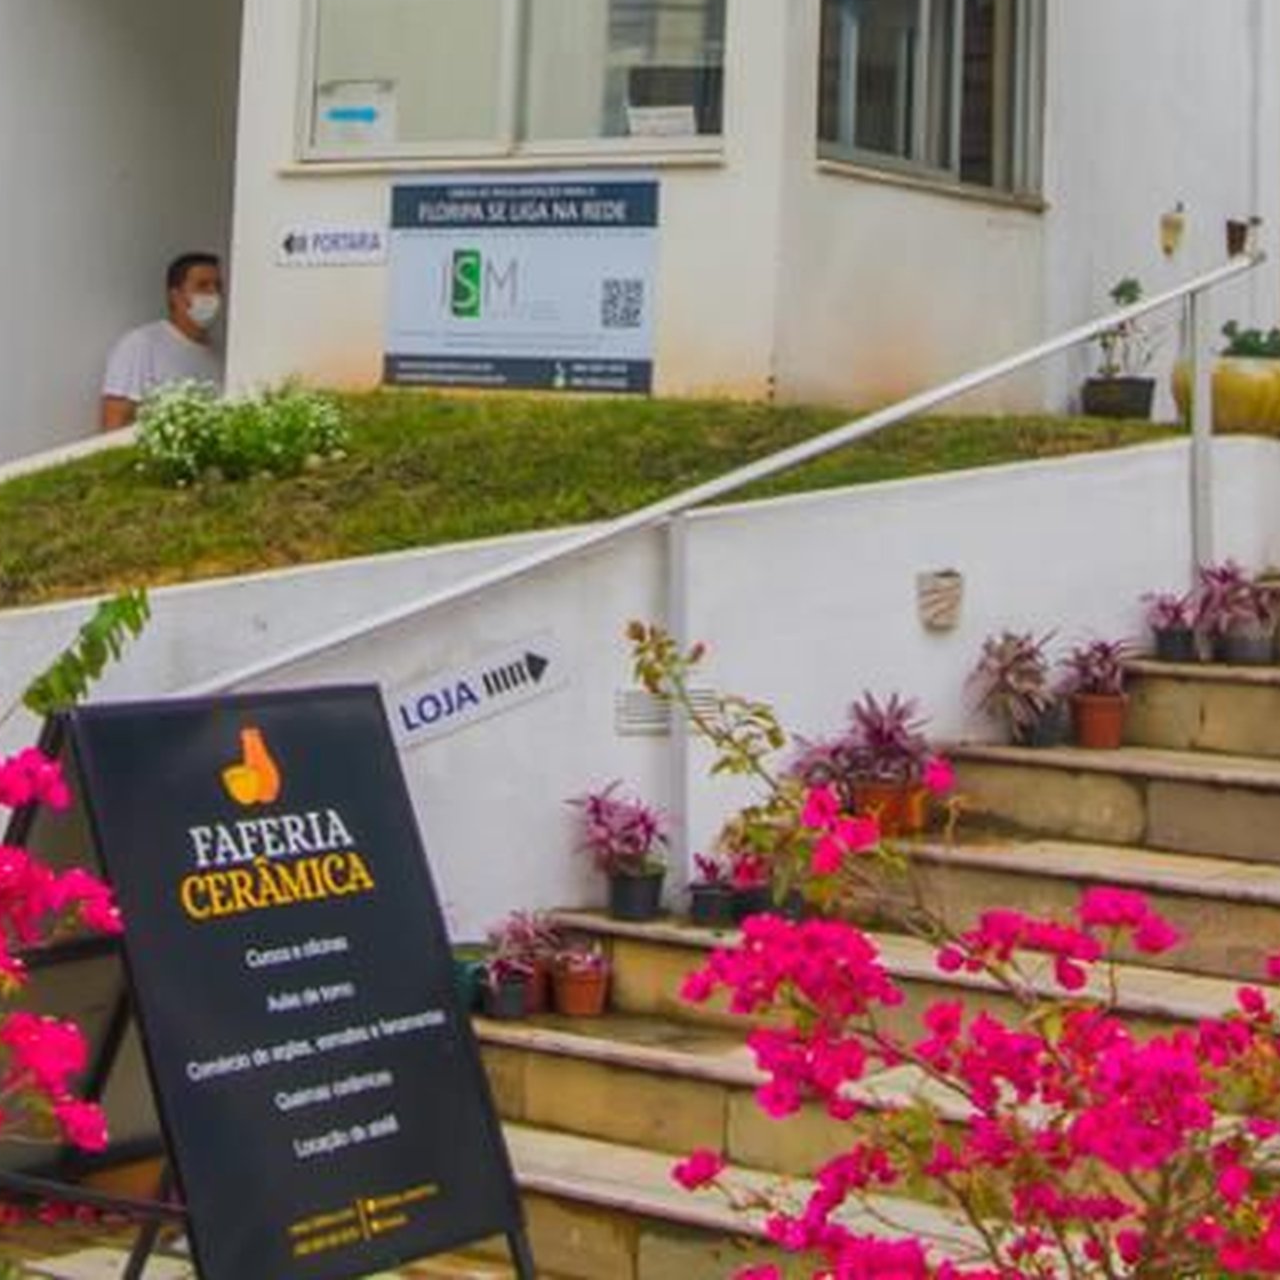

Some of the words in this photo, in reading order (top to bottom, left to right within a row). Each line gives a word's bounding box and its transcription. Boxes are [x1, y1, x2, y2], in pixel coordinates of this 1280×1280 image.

[421, 200, 483, 220] FLORIPA
[487, 200, 507, 220] SE
[510, 199, 548, 220] LIGA
[552, 198, 578, 219] NA
[582, 198, 627, 219] REDE
[313, 231, 381, 252] PORTARIA
[399, 680, 480, 732] LOJA
[188, 808, 354, 868] FAFERIA
[180, 851, 375, 919] CERÂMICA
[245, 947, 291, 969] Cursos
